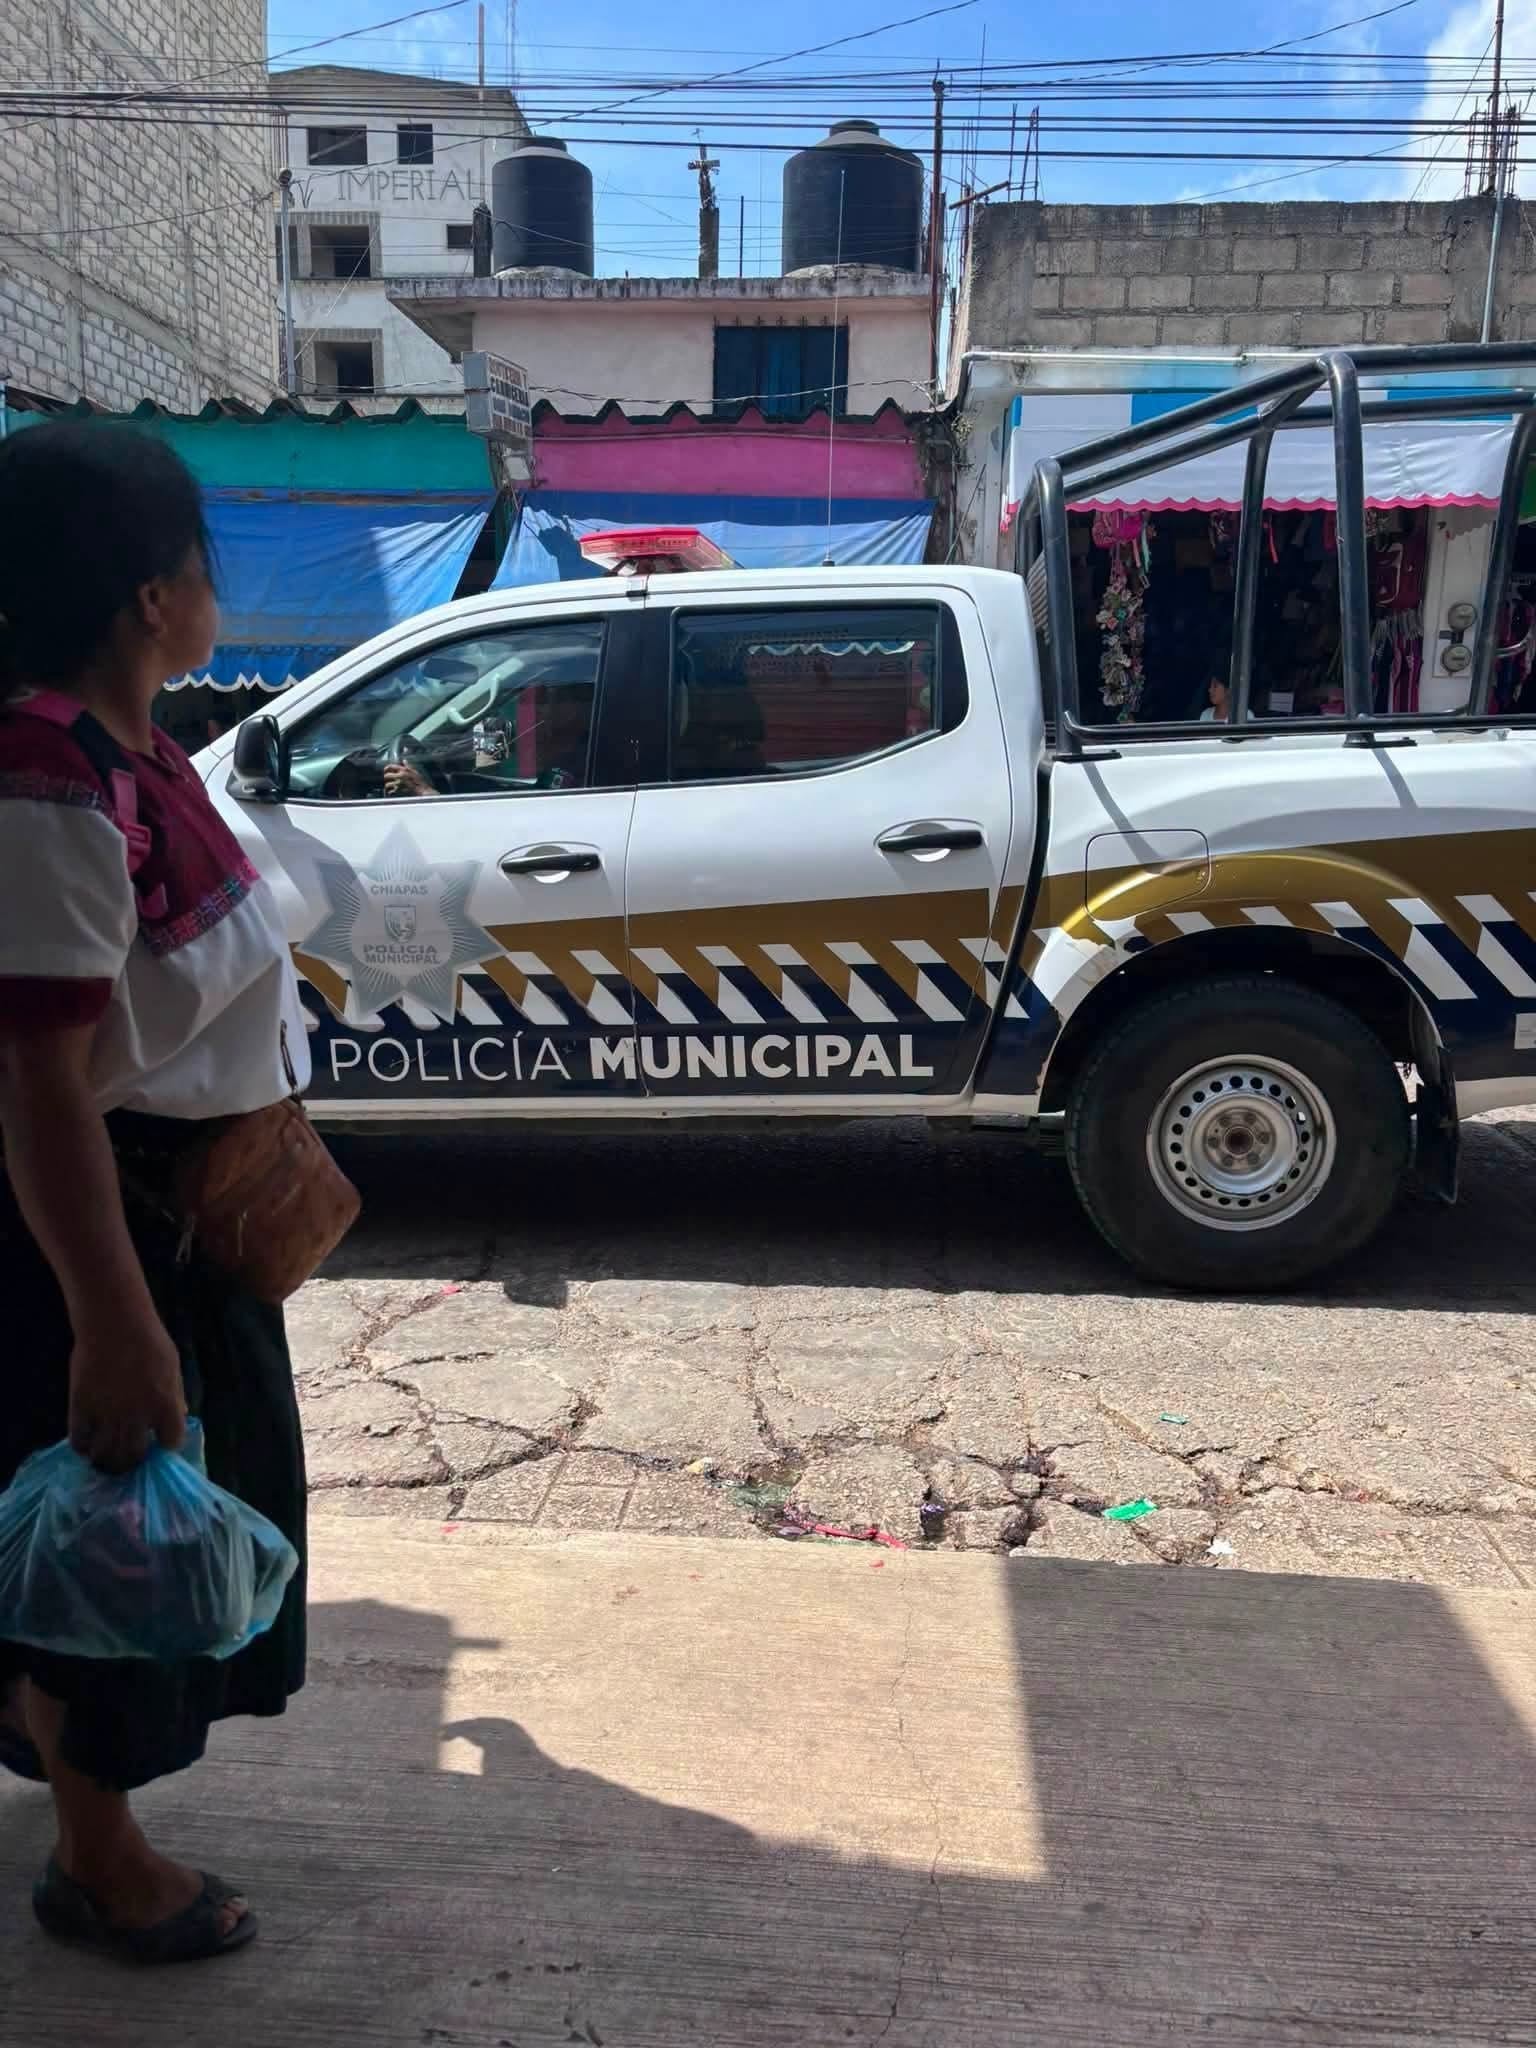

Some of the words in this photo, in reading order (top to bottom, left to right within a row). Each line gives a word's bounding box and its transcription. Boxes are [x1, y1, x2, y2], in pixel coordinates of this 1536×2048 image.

[337, 168, 483, 201] IMPERIAL
[370, 885, 428, 896] CHIAPAS
[366, 954, 440, 964] MUNICIPAL
[329, 1030, 572, 1081] POLICÍA
[589, 1034, 934, 1079] MUNICIPAL
